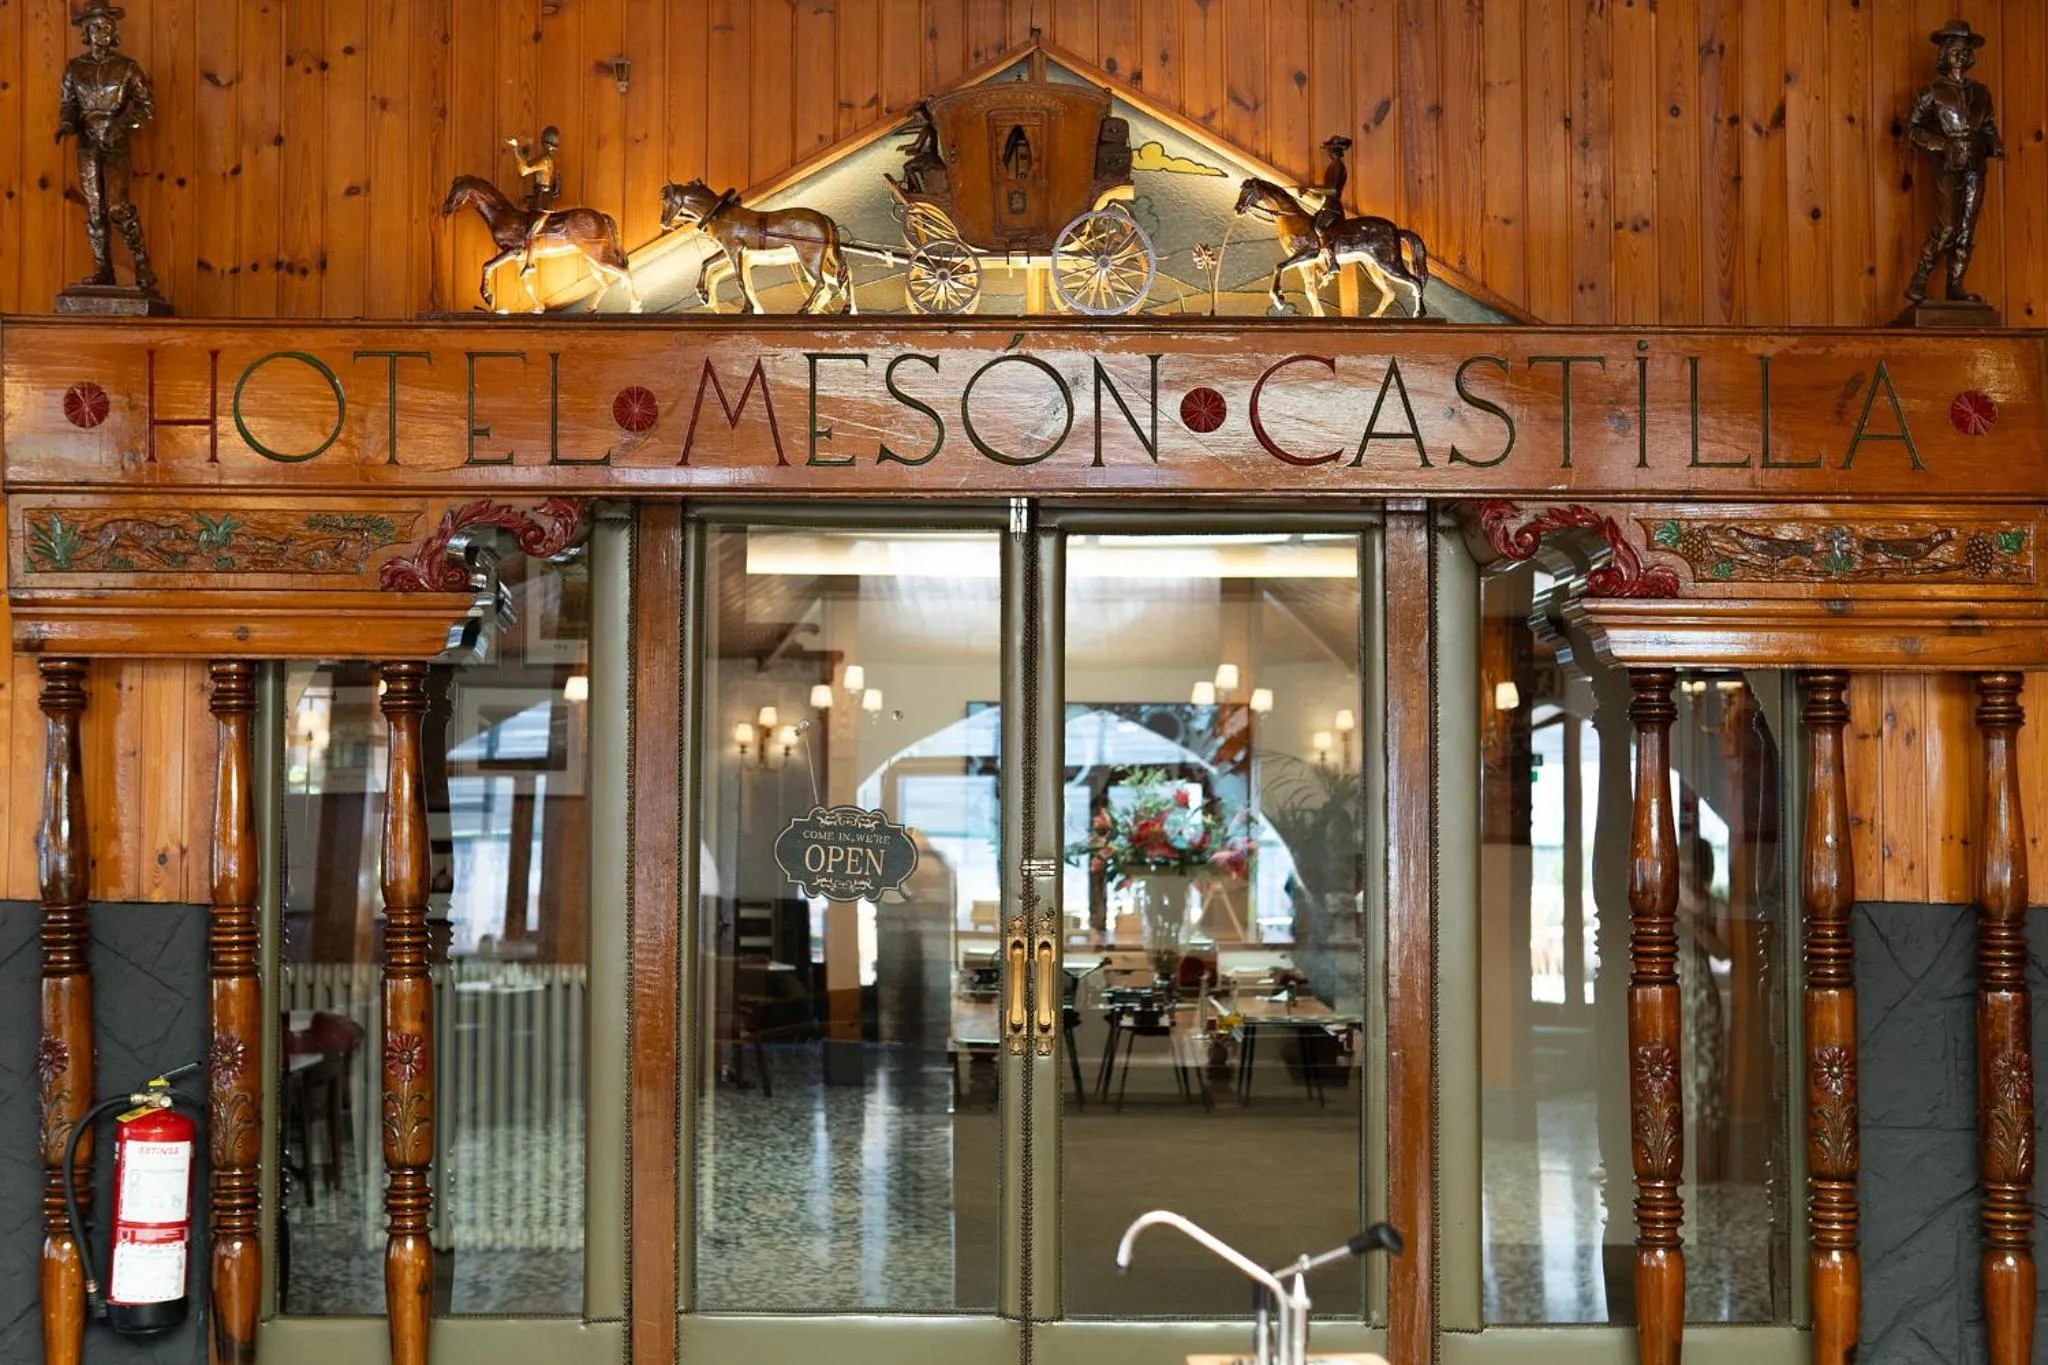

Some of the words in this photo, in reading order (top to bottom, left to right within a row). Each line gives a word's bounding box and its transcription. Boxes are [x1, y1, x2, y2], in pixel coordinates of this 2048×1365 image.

[145, 348, 611, 465] HOTEL
[676, 332, 1163, 467] MESÓN
[802, 829, 835, 841] COME
[804, 844, 885, 877] OPEN
